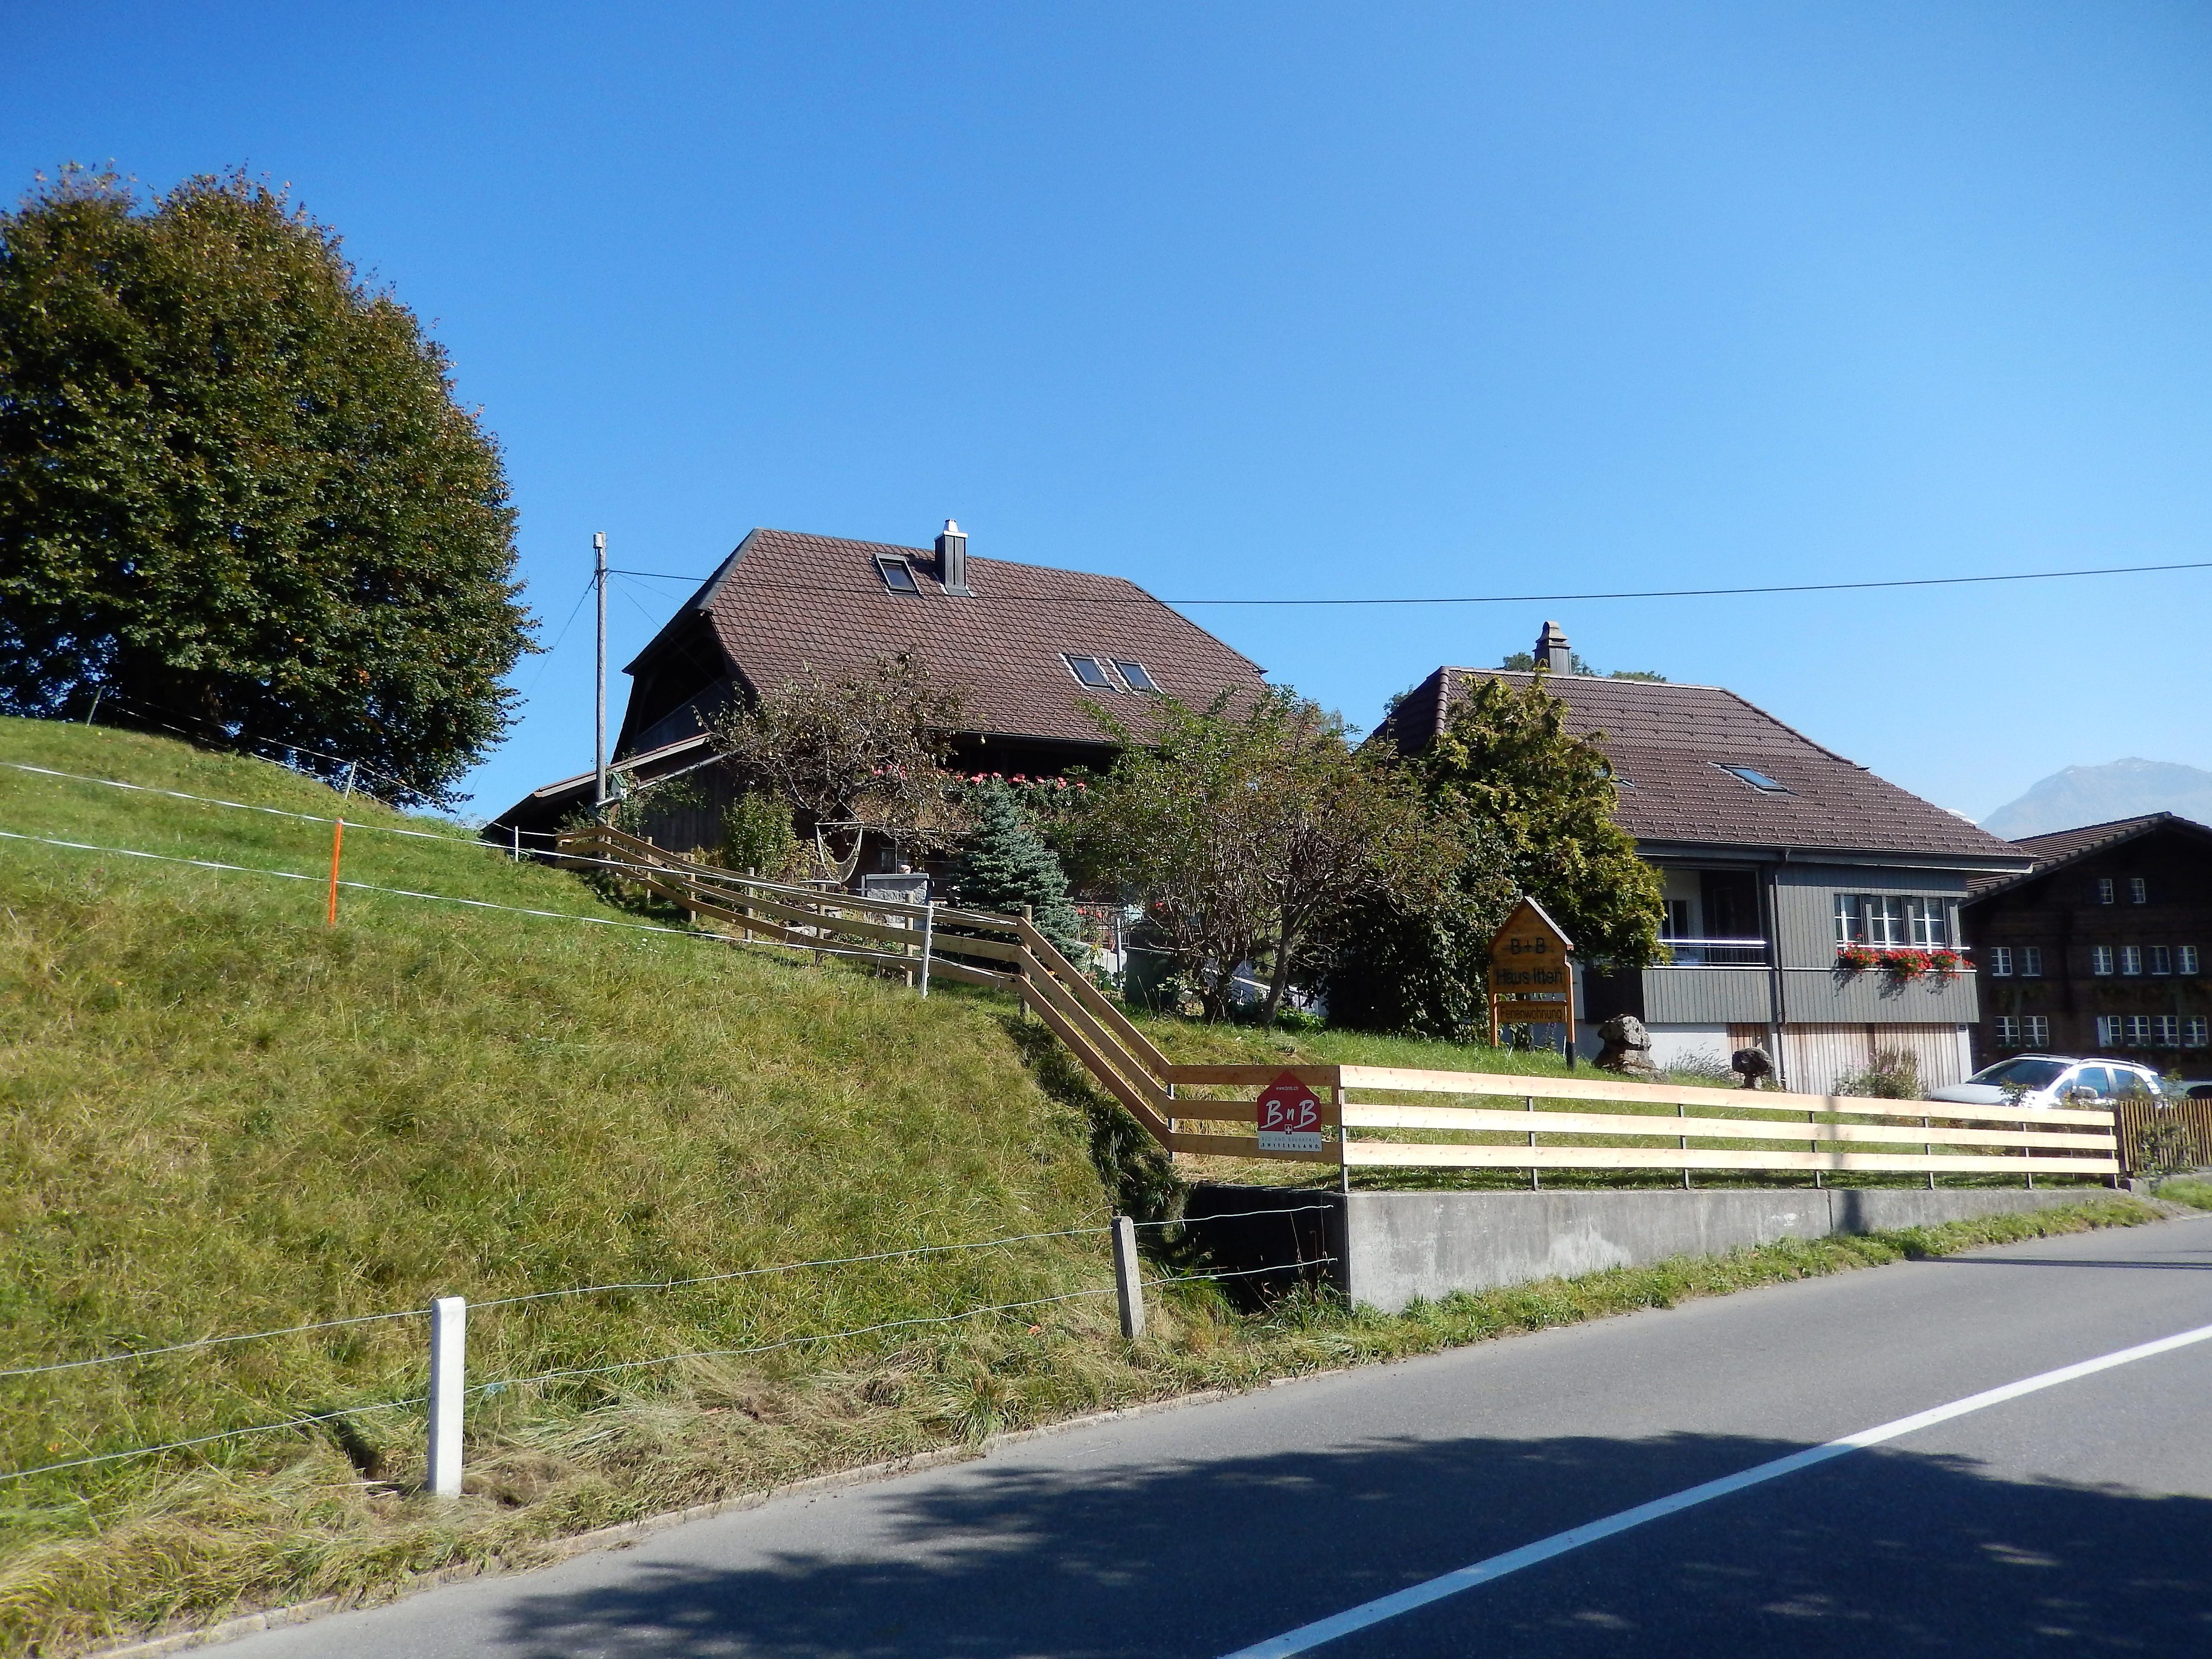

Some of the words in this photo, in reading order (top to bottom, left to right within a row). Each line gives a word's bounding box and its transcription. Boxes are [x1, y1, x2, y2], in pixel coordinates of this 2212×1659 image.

[1496, 968, 1529, 985] Haus
[1500, 1007, 1562, 1022] Ferienwohnung
[1261, 1099, 1317, 1129] BnB
